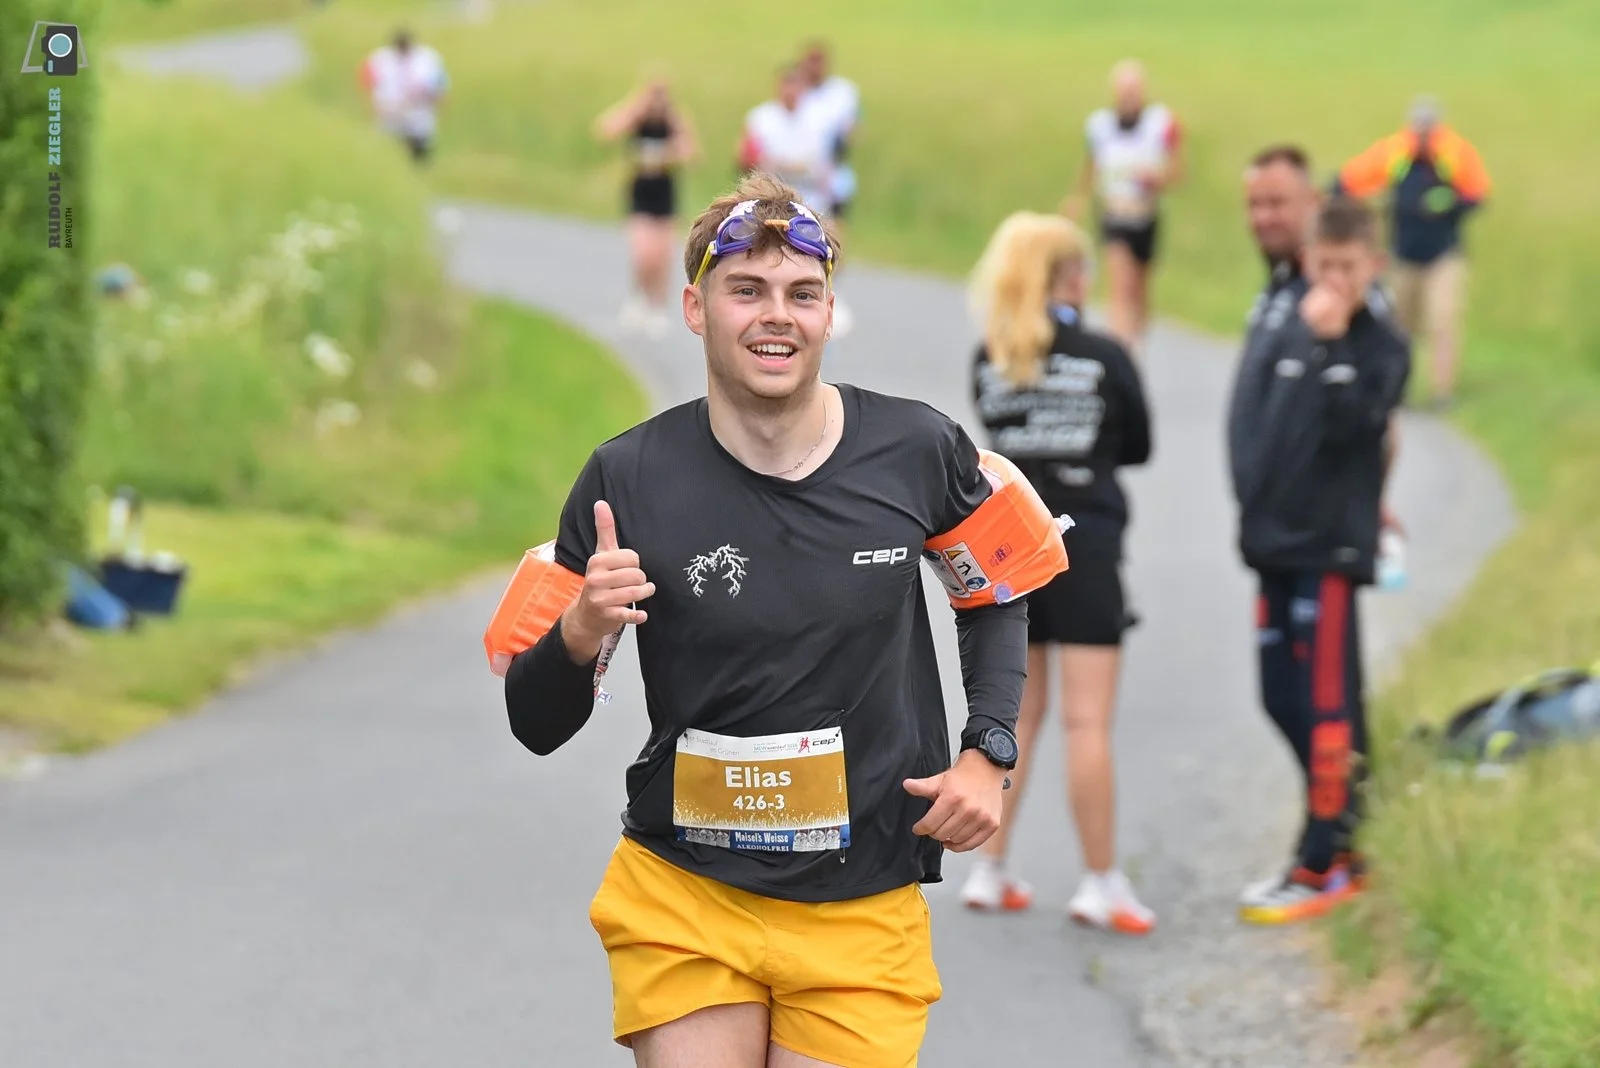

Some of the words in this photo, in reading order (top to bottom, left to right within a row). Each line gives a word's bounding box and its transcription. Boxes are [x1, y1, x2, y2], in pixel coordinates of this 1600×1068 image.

[852, 547, 908, 565] cep
[811, 738, 836, 746] cep
[725, 766, 792, 788] Elias
[733, 794, 785, 810] 426-3
[735, 831, 763, 843] Maisel's
[763, 832, 789, 843] Weisse
[736, 844, 790, 852] ALKOHOLFREI
